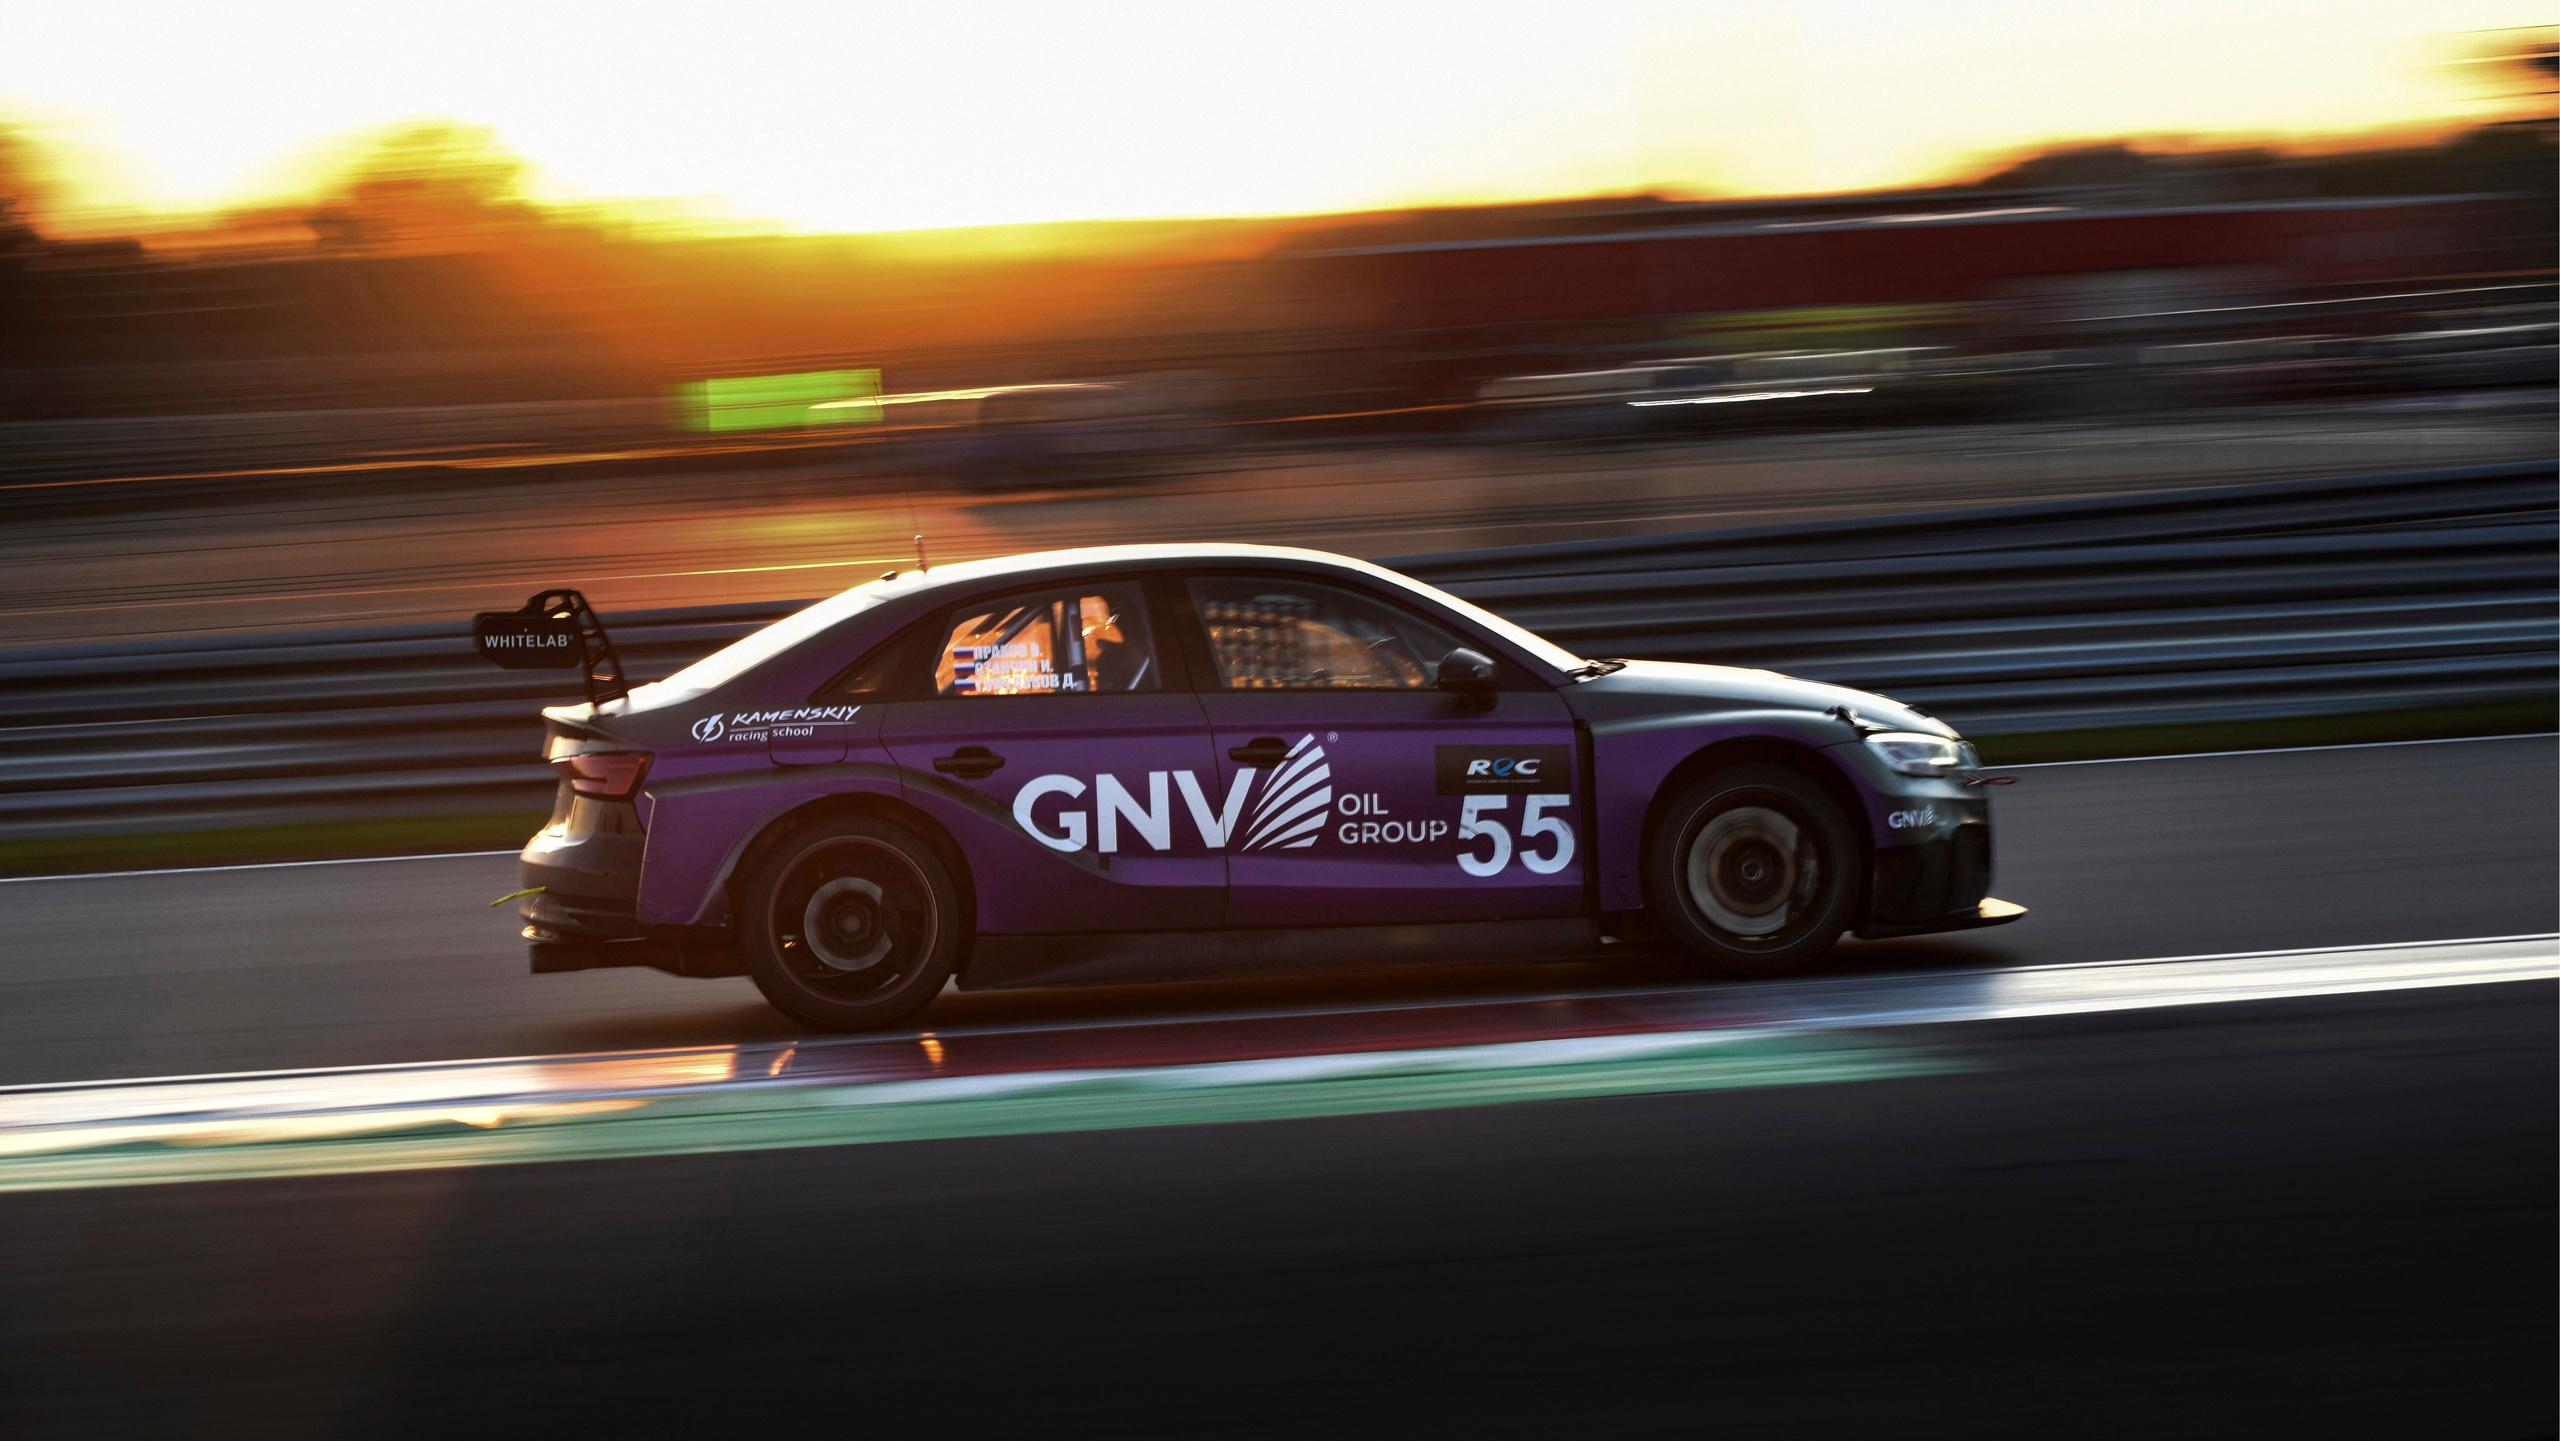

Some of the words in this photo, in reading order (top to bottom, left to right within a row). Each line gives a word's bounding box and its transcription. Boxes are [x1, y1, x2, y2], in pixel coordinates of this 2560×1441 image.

[485, 634, 568, 648] WHITELAB
[731, 705, 862, 726] KAMENSKIY
[729, 730, 769, 742] racing
[772, 726, 814, 737] school
[1012, 768, 1258, 853] GNV
[1338, 793, 1389, 816] OIL
[1888, 809, 1926, 829] GNV
[1337, 819, 1449, 846] GROUP
[1456, 794, 1577, 877] 55
